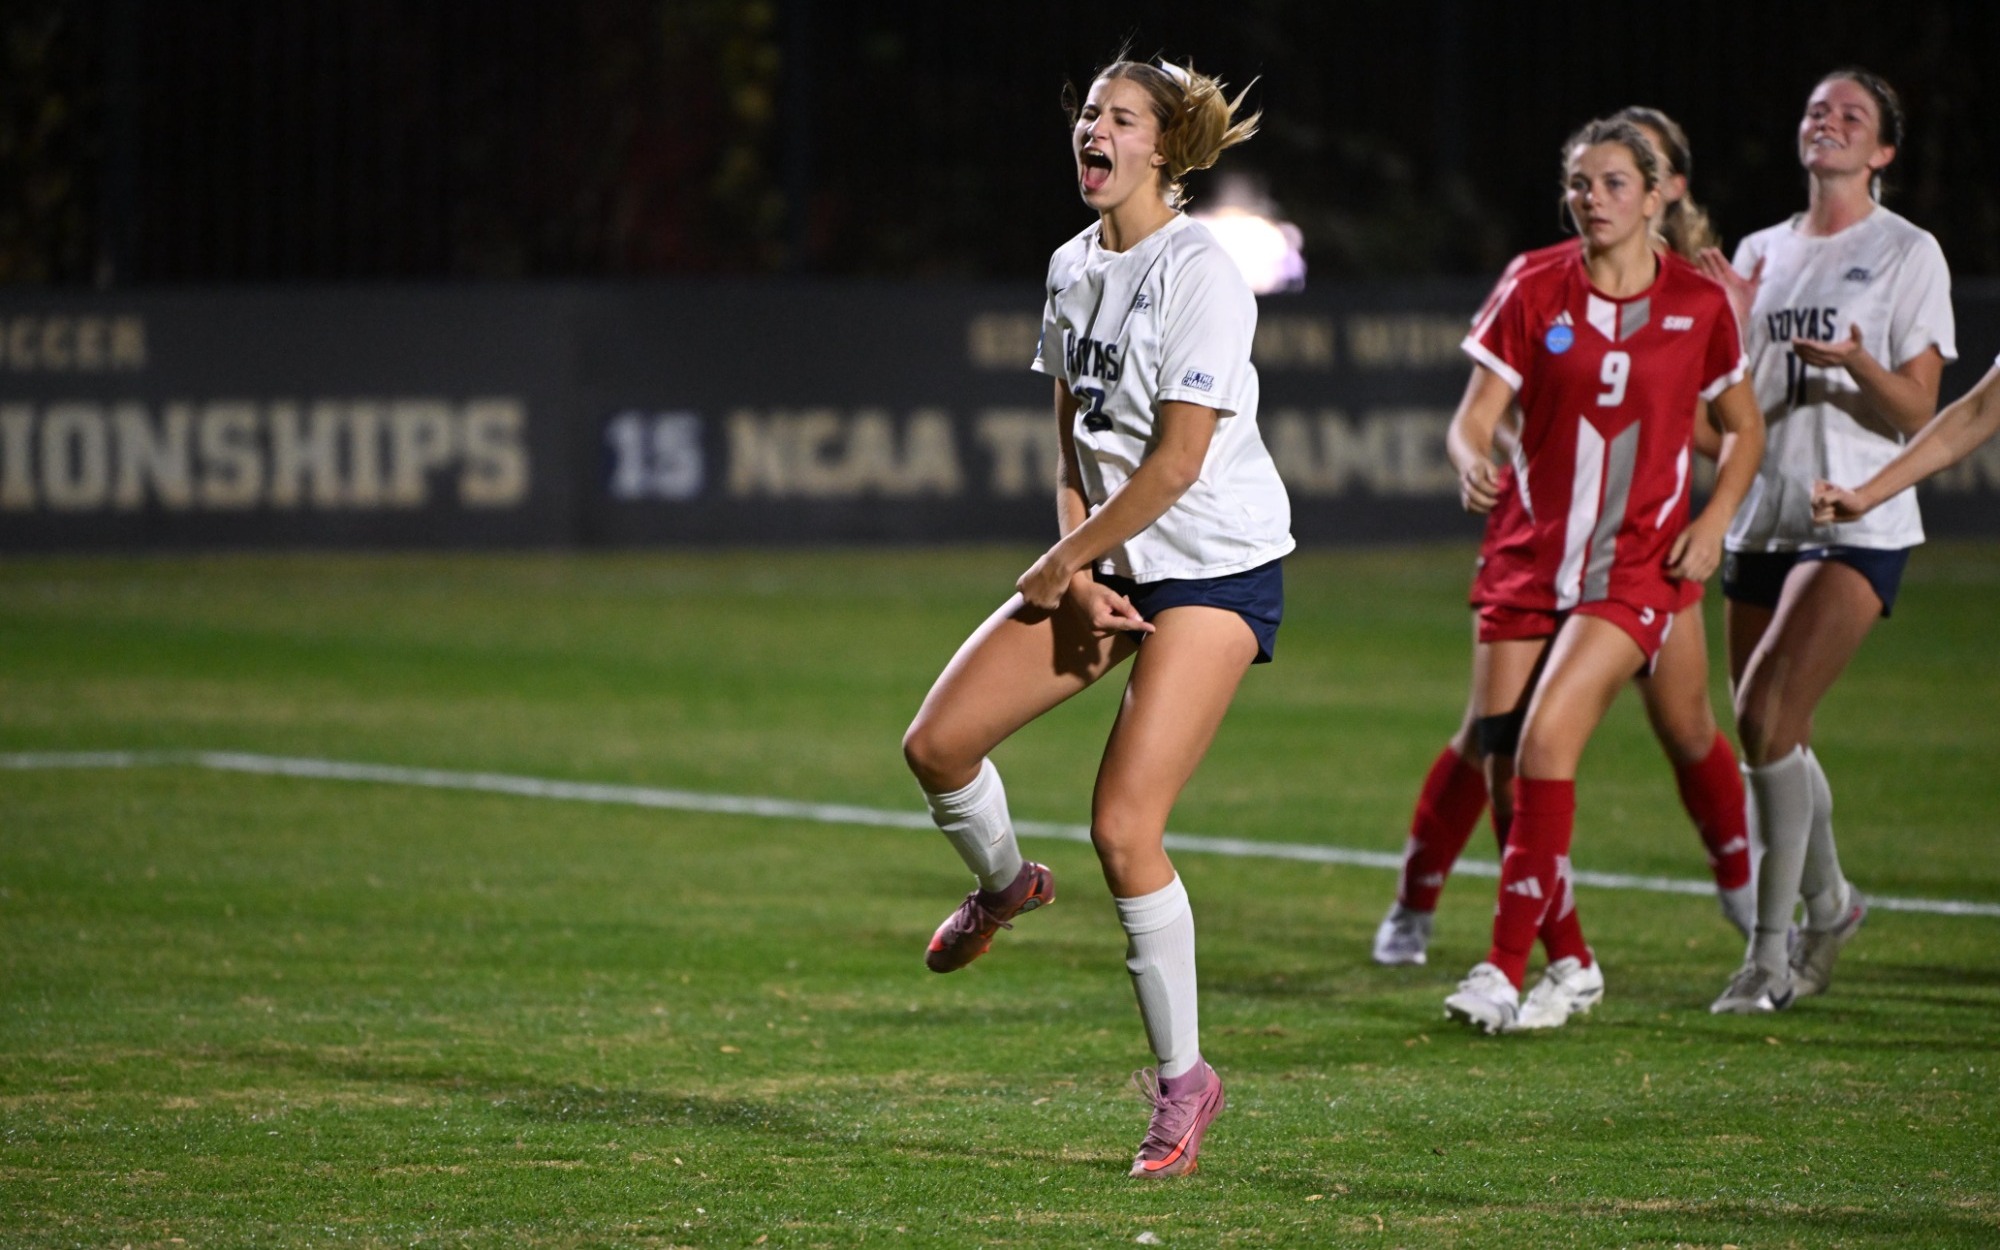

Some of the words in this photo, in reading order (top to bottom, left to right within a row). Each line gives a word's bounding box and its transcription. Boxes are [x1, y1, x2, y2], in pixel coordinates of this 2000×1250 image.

[0, 314, 145, 371] CCER
[1596, 351, 1630, 406] 9
[0, 398, 528, 507] IONSHIPS
[727, 410, 963, 496] NCAA
